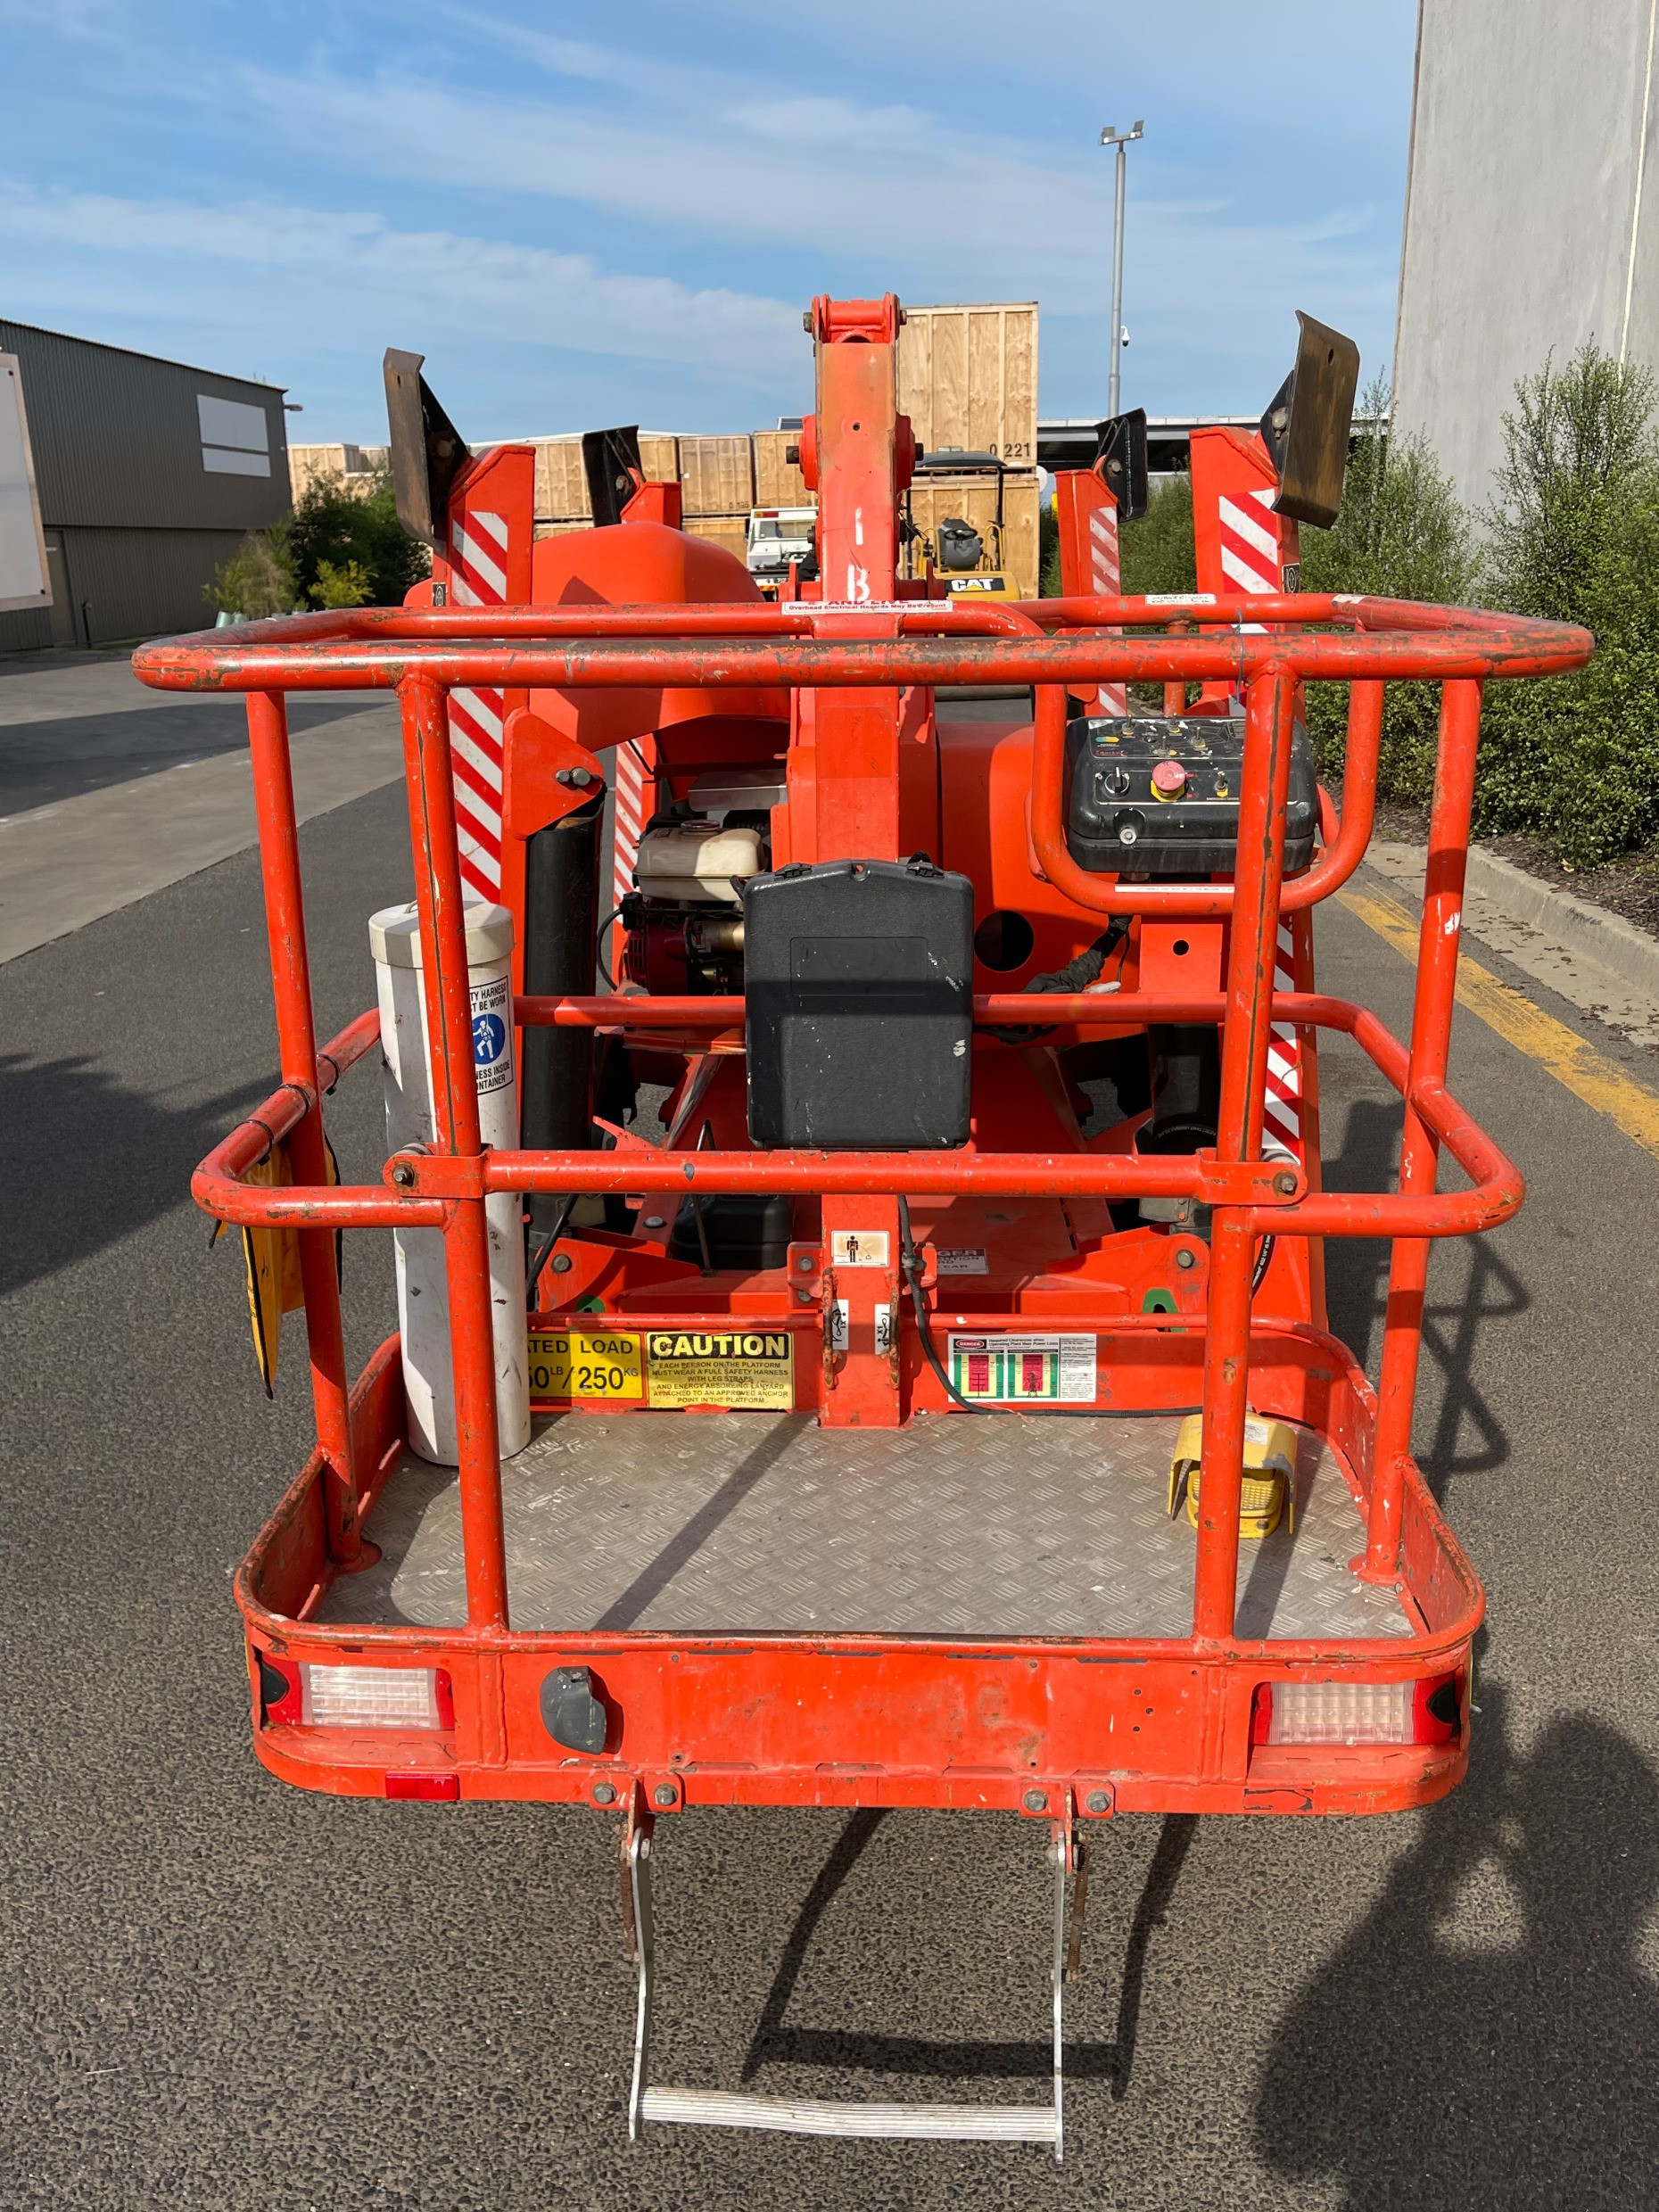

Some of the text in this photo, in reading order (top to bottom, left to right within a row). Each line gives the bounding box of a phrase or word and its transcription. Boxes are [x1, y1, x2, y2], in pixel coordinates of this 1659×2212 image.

[951, 578, 995, 592] CAT
[482, 983, 507, 999] HARNESS
[479, 1001, 488, 1011] BE
[493, 1061, 511, 1076] INSIDE
[477, 1073, 506, 1090] NTAINER
[580, 1340, 633, 1354] LOAD
[653, 1335, 785, 1357] CAUTION
